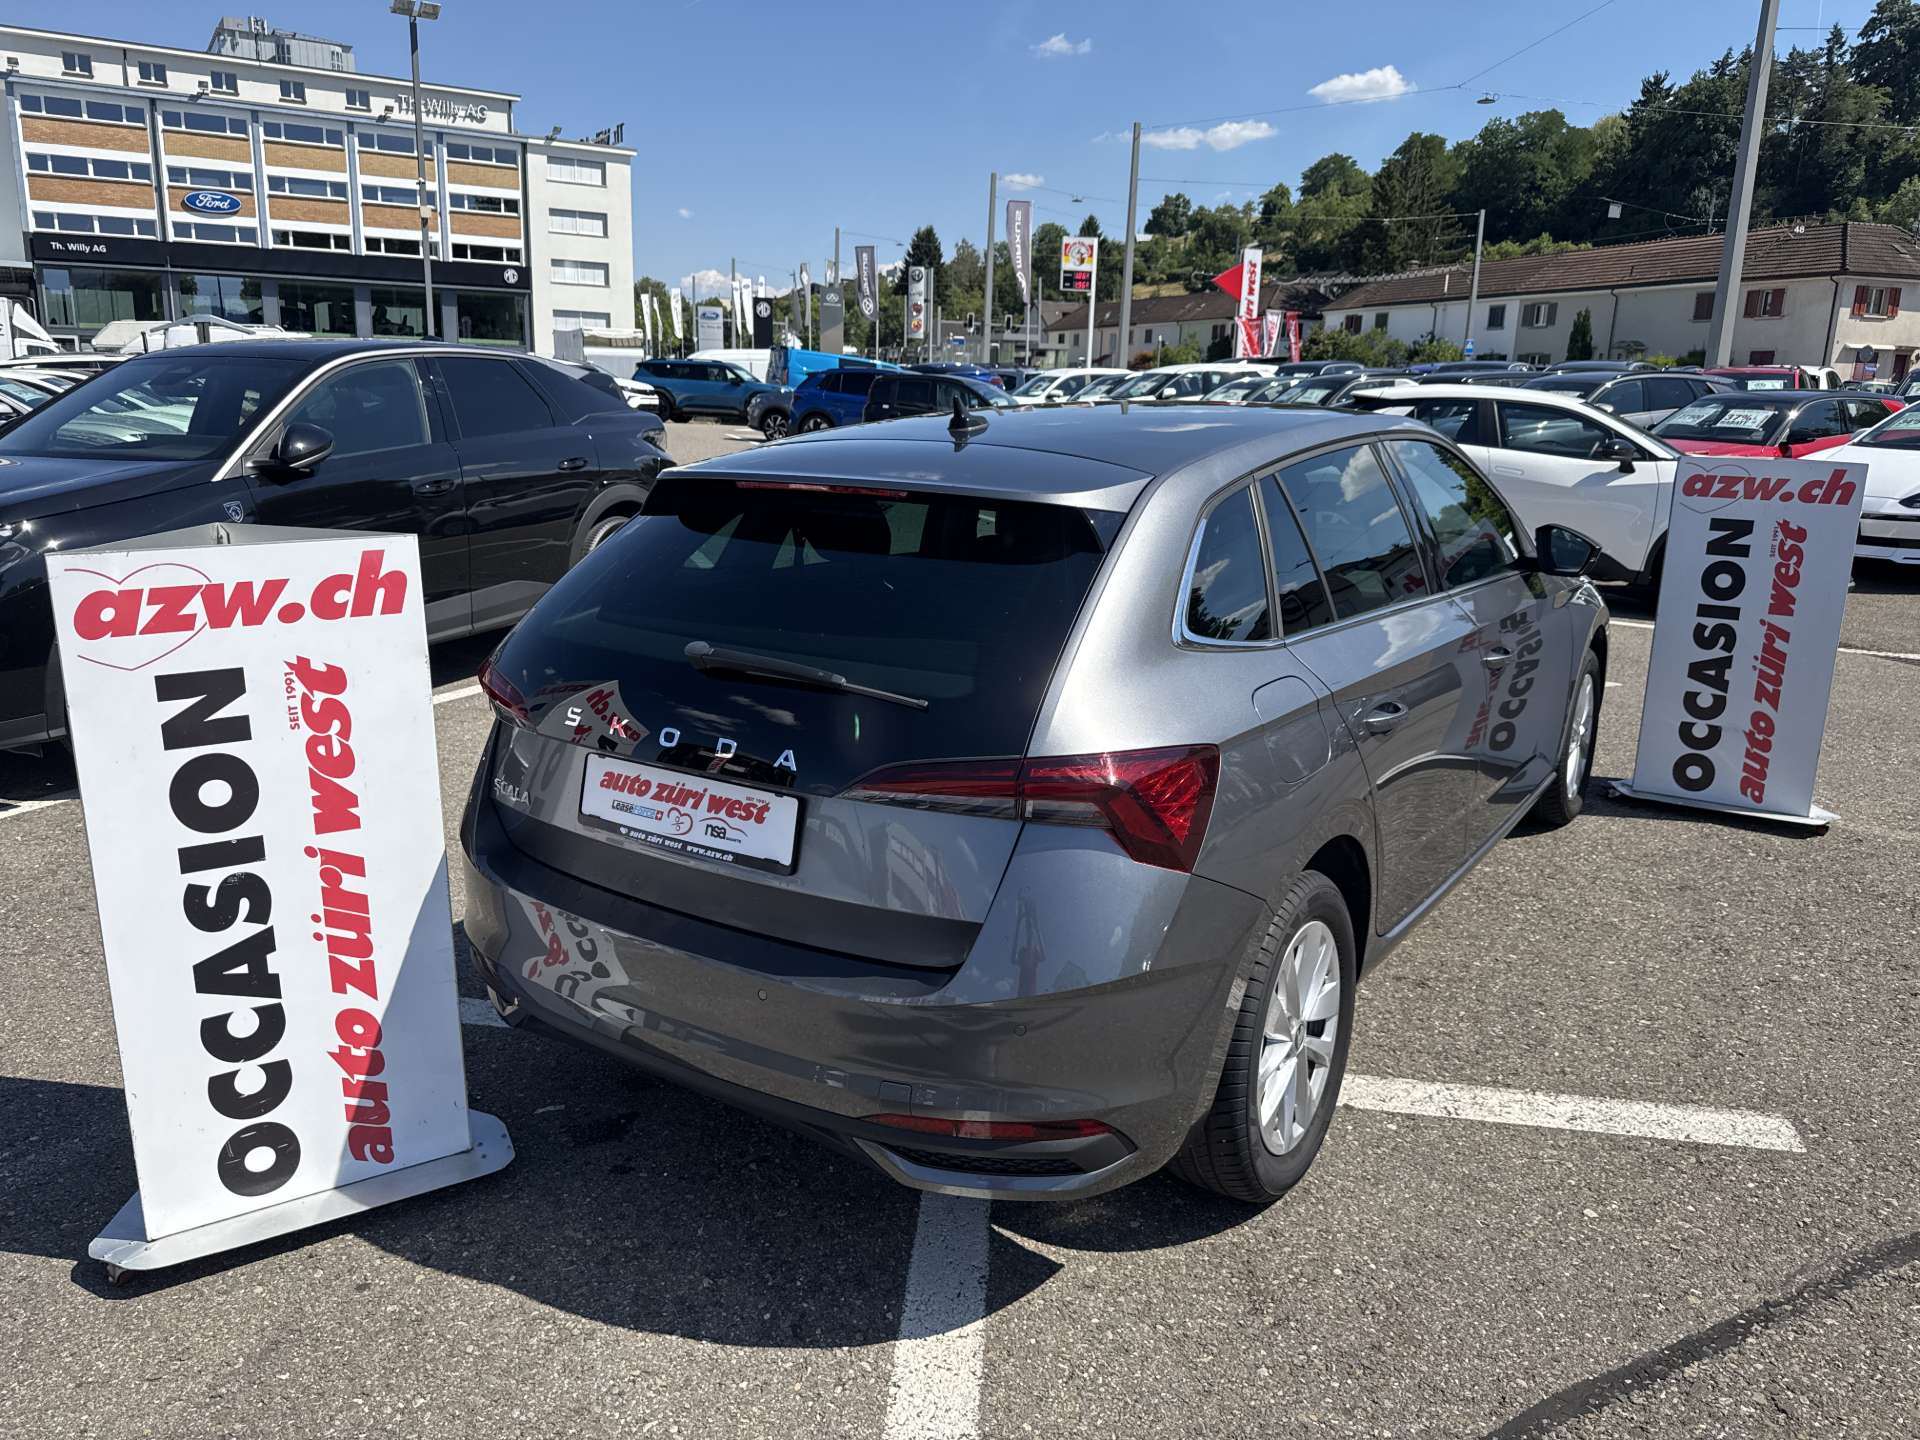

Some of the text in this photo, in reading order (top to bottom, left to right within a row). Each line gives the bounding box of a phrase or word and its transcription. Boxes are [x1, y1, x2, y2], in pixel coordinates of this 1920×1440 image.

[466, 103, 489, 119] AG
[195, 193, 231, 210] Ford
[50, 242, 107, 253] Th. Willy AG
[1682, 469, 1858, 506] azw.ch
[73, 550, 408, 641] azw.ch
[1672, 518, 1755, 792] OCCASION
[1739, 518, 1808, 806] auto züri west
[283, 671, 301, 731] SEIT 1991
[600, 771, 771, 824] auto züri west
[629, 830, 646, 840] auto
[664, 839, 683, 849] west
[686, 844, 734, 861] www.azw.ch
[705, 823, 727, 840] nsa
[154, 667, 301, 1195] OCCASION
[284, 655, 394, 1165] auto züri west
